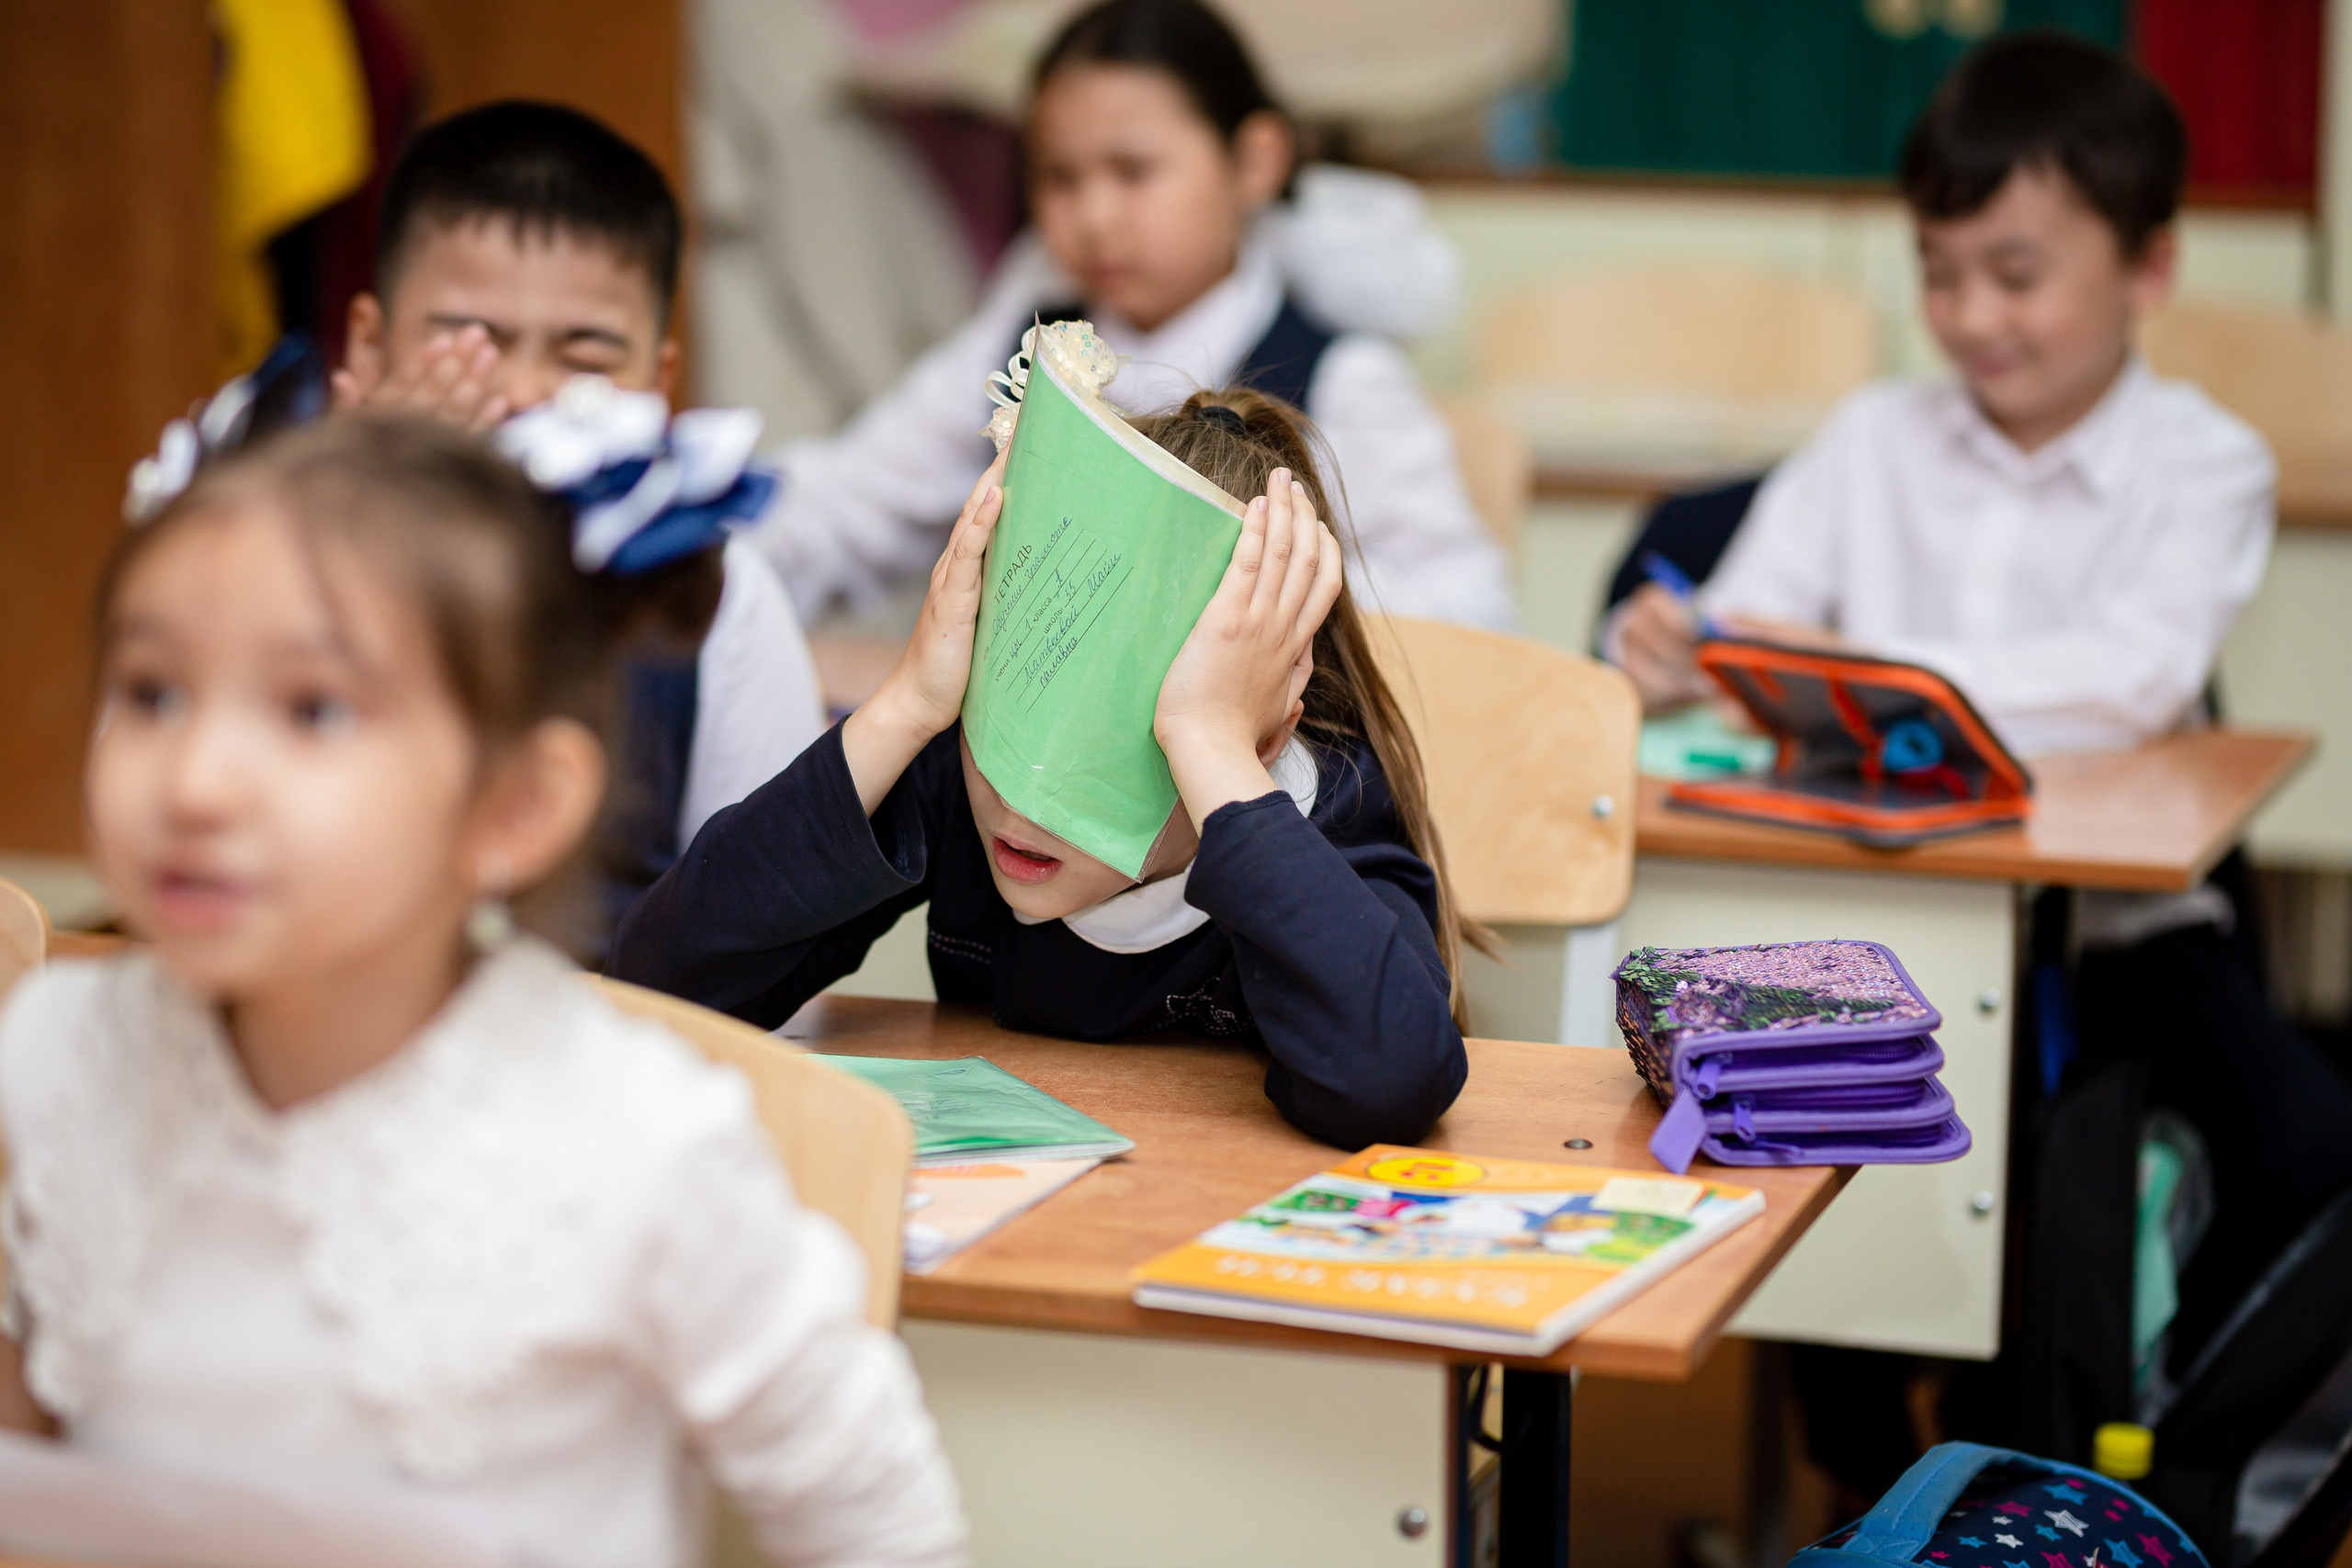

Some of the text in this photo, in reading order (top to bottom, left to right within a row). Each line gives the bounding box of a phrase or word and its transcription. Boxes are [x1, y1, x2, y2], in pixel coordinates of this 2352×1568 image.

[993, 544, 1033, 604] ТЕТРАДЬ
[1033, 597, 1052, 623] класса
[1043, 579, 1078, 635] школы 55
